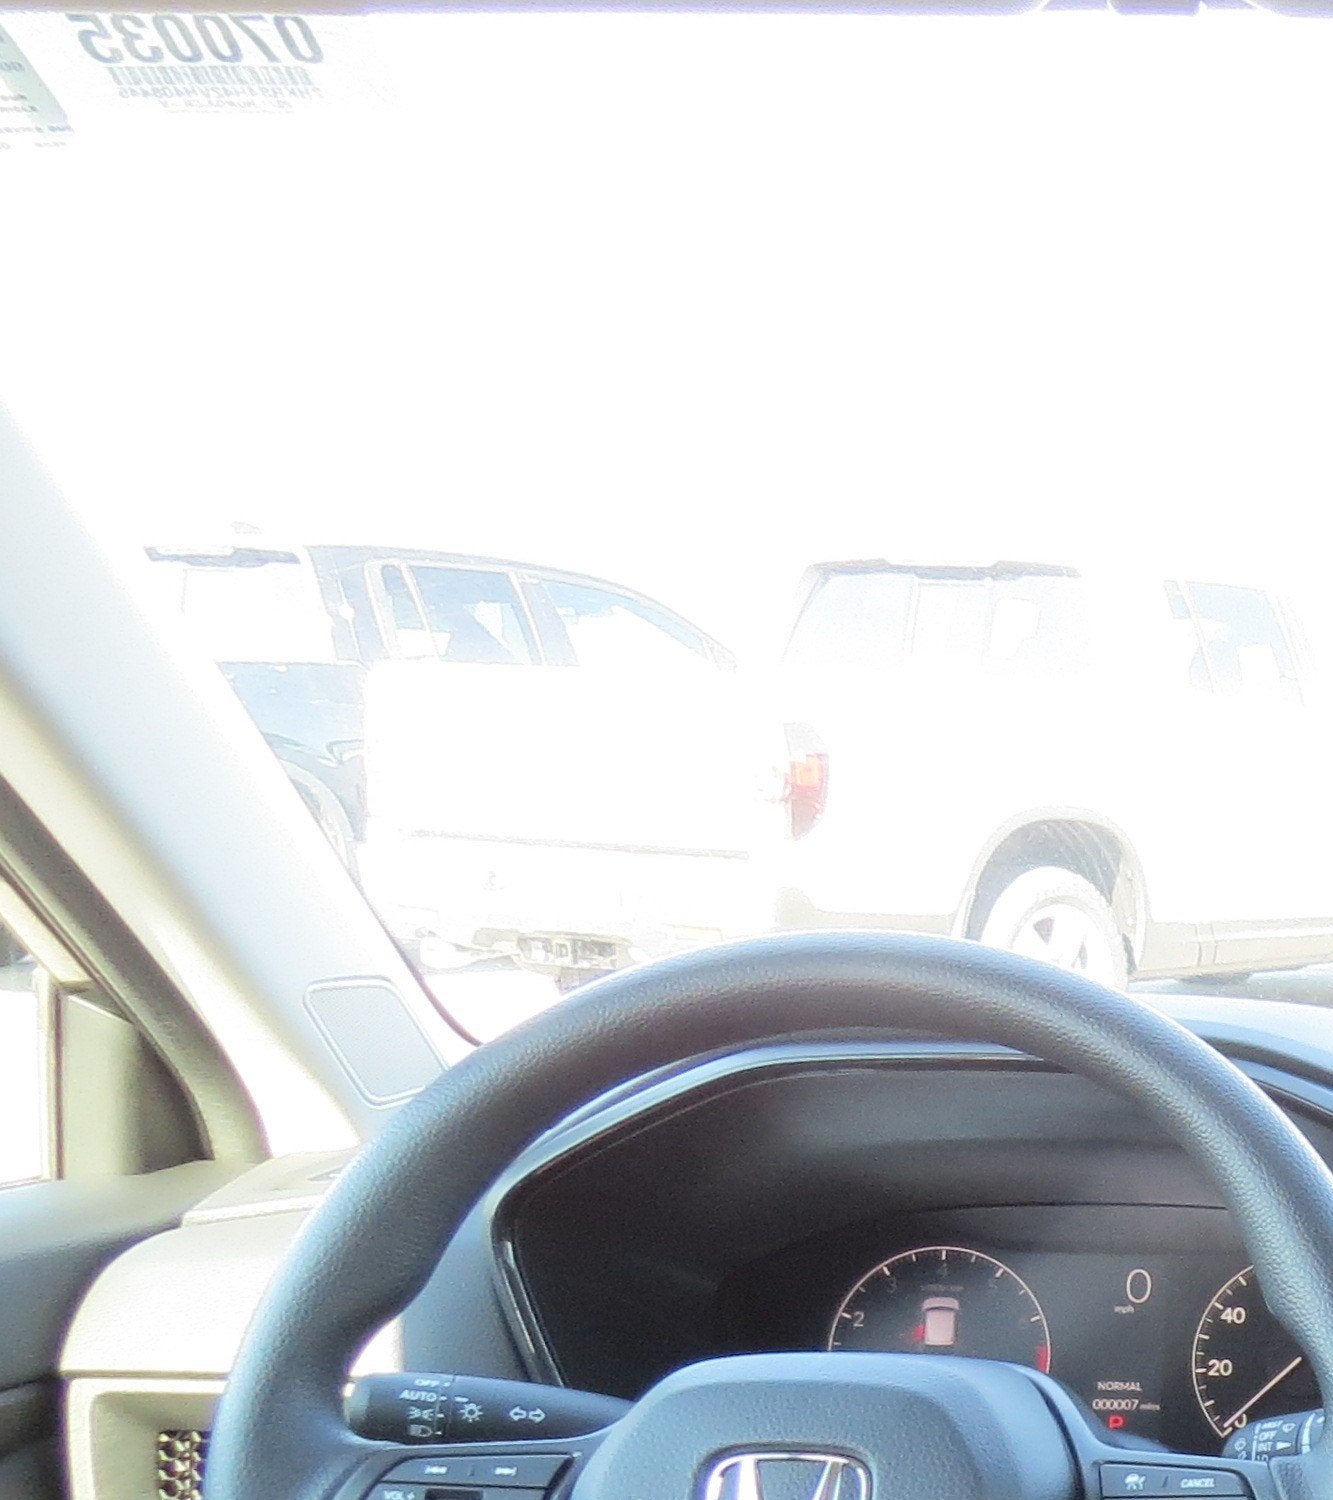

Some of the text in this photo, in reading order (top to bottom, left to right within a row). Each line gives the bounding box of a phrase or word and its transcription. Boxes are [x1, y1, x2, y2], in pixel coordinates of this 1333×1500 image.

[1126, 1268, 1151, 1303] 0
[1114, 1305, 1135, 1314] mph
[1220, 1306, 1246, 1324] 40
[853, 1311, 864, 1327] 2
[1208, 1359, 1233, 1376] 20
[414, 1379, 440, 1387] OFF
[1097, 1381, 1142, 1392] NORMAL
[399, 1389, 438, 1402] AUTO
[1092, 1399, 1139, 1411] 000007
[1109, 1415, 1125, 1430] P
[1259, 1430, 1278, 1441] OFF
[1180, 1478, 1215, 1488] CANCEL
